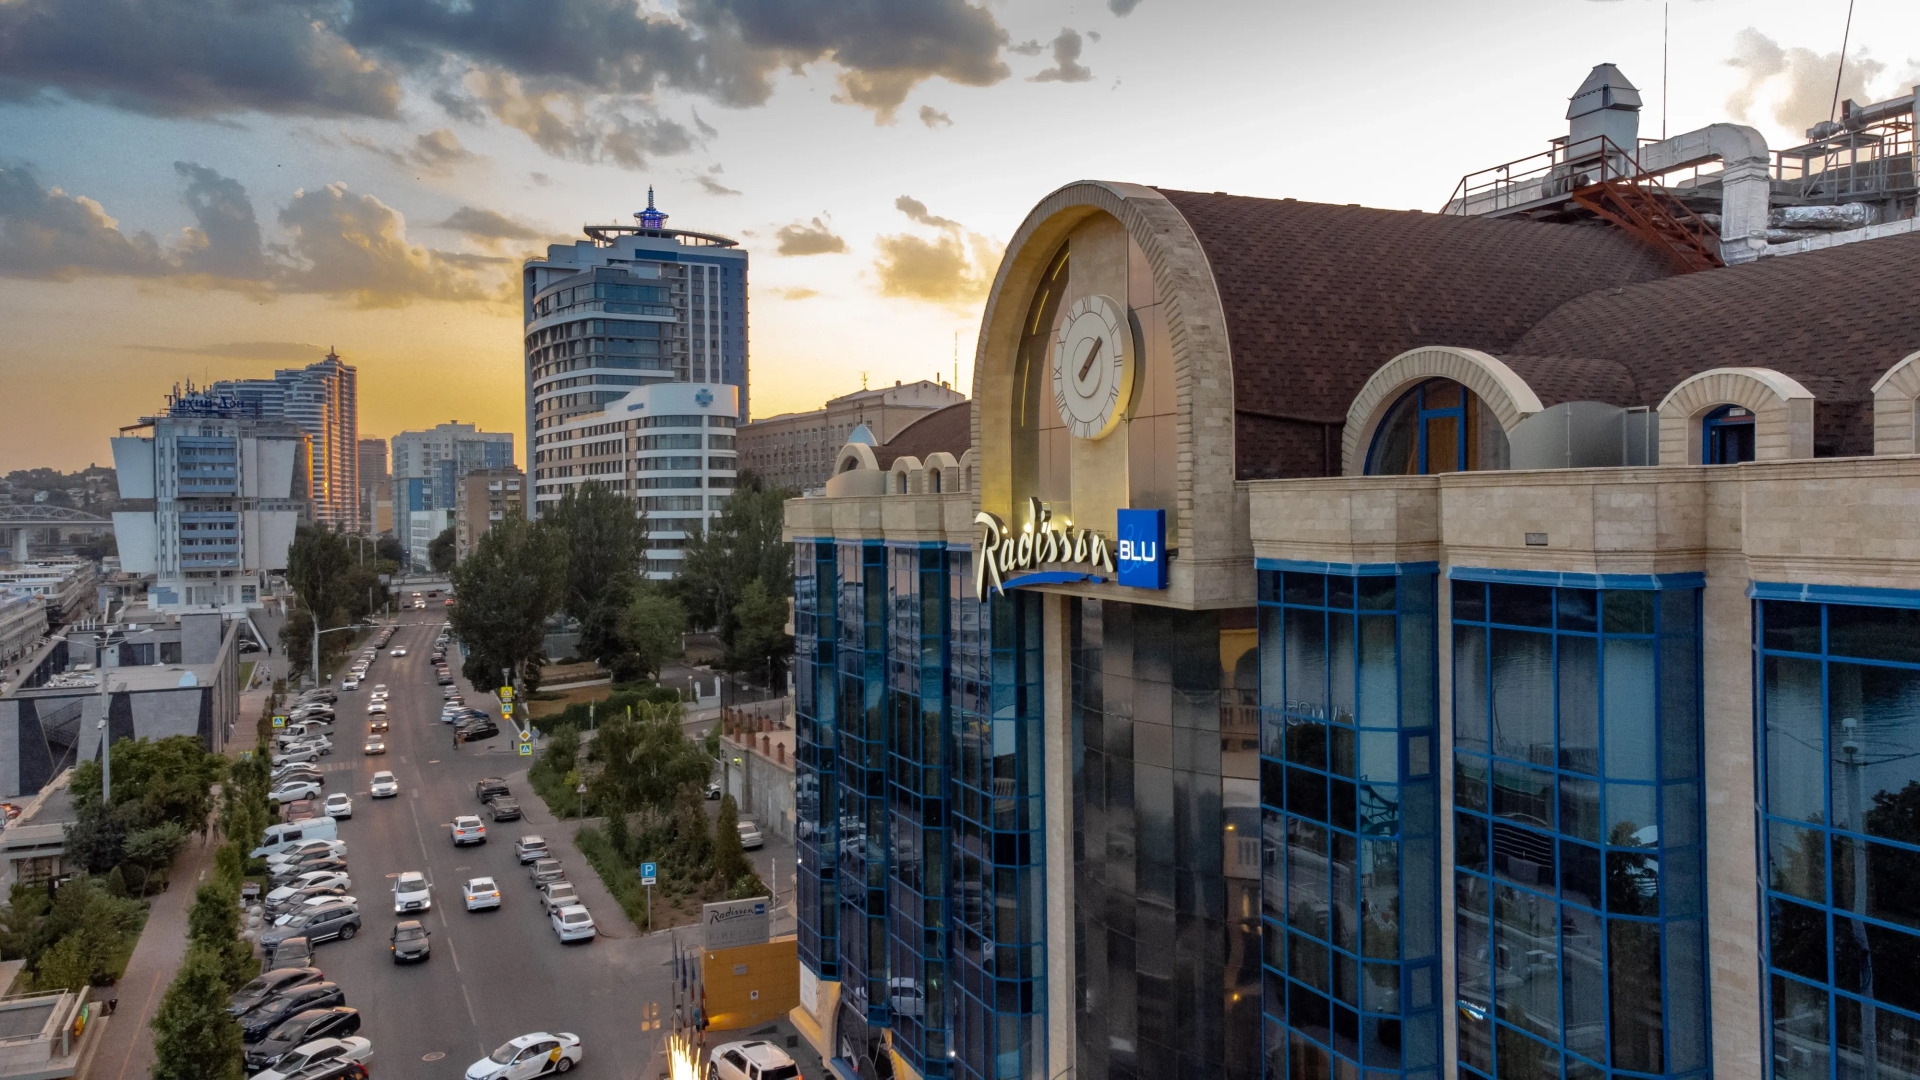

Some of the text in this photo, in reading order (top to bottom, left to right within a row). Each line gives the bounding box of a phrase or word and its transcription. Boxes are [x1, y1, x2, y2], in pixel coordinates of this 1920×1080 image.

[974, 496, 1156, 603] Radisson BLU
[645, 864, 654, 876] P
[710, 906, 754, 925] Radisson
